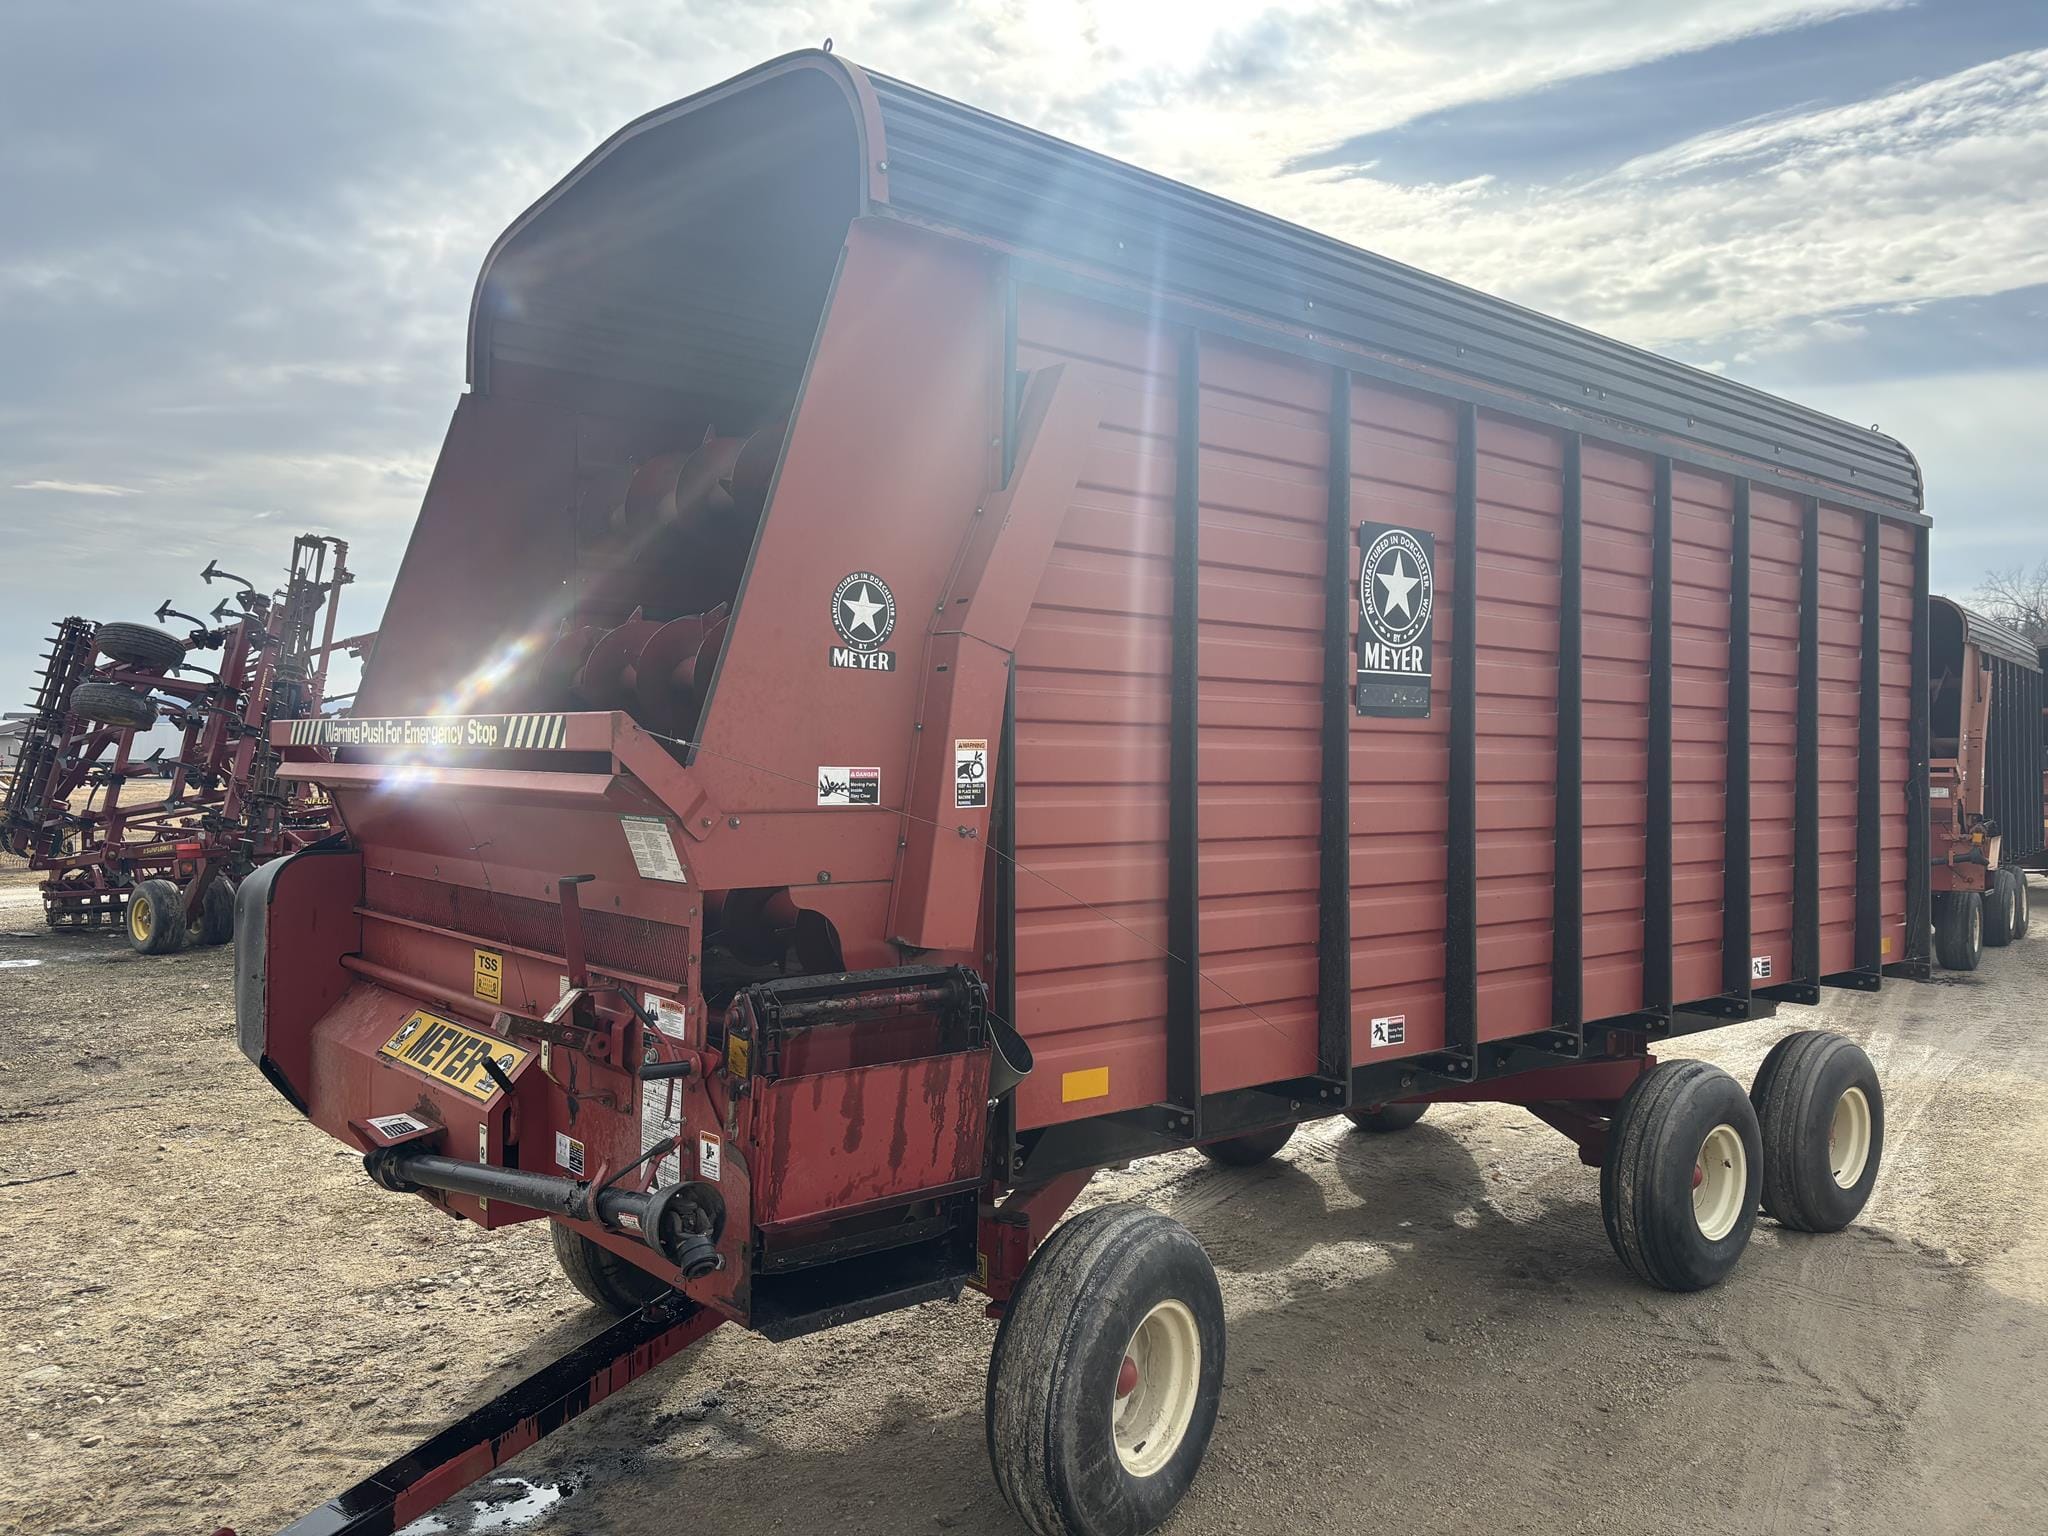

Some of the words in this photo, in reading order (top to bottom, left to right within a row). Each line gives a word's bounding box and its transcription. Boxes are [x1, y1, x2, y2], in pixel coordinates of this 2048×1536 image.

[1364, 540, 1389, 615] MANUFACTURED
[1390, 536, 1399, 545] IN
[832, 573, 859, 626] MANUFACTURED
[1393, 634, 1401, 643] BY
[833, 648, 889, 671] MEYER
[1364, 641, 1423, 672] MEYER
[324, 721, 360, 745] Warning
[361, 721, 384, 744] Push
[385, 720, 402, 744] For
[404, 720, 464, 746] Emergency
[467, 718, 498, 747] Stop
[478, 955, 498, 972] TSS
[404, 1022, 493, 1083] MEYER
